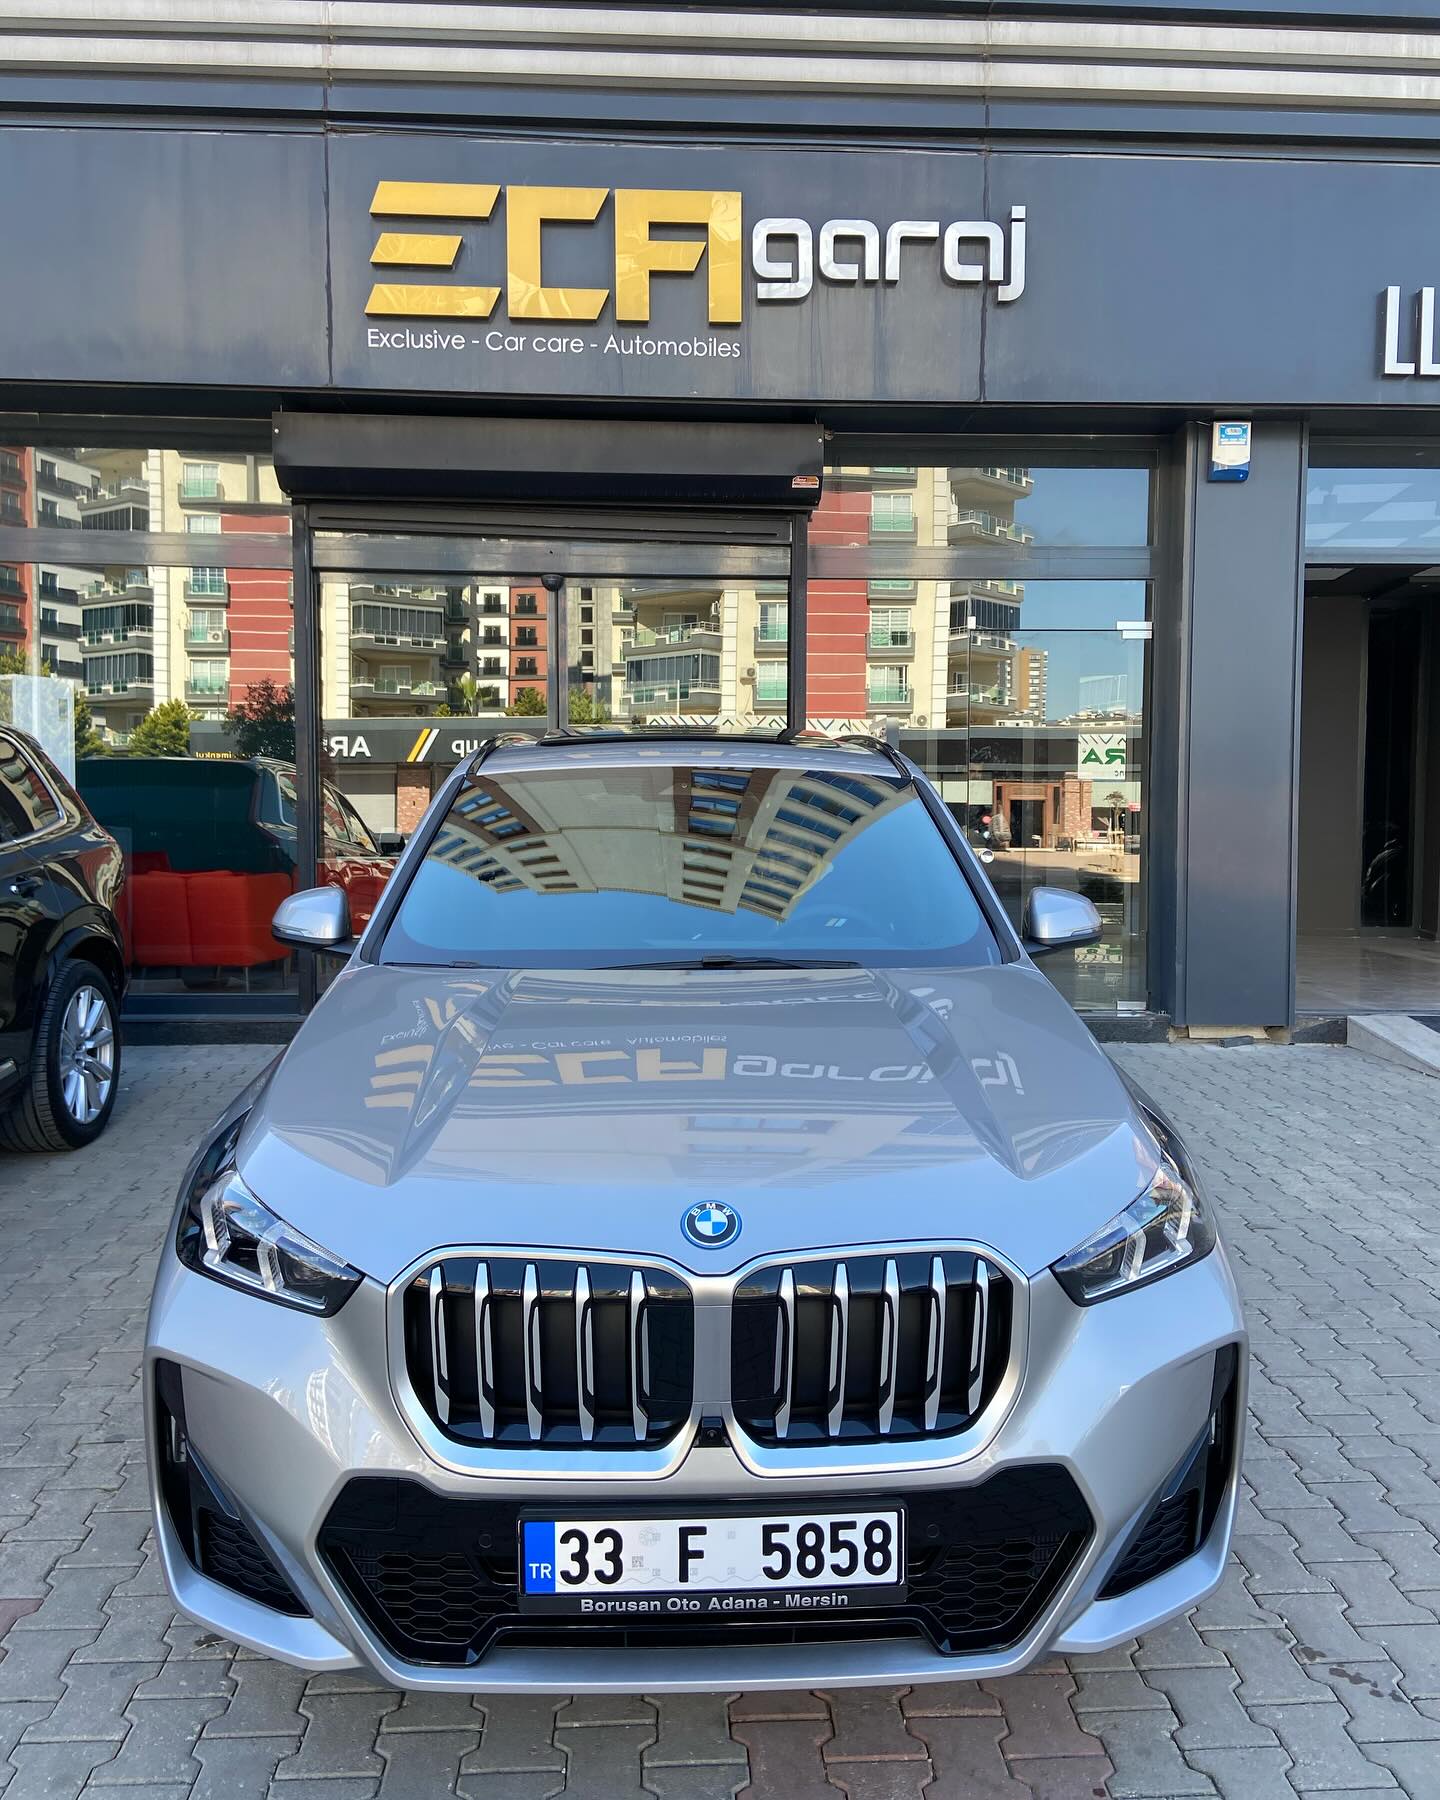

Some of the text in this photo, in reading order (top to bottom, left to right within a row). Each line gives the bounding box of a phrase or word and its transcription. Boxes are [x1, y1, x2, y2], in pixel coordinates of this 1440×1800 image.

[751, 205, 1027, 303] garaj
[366, 328, 466, 350] Exclusive
[485, 331, 527, 352] Car
[532, 336, 584, 352] care
[603, 333, 741, 358] Automobiles
[691, 1202, 733, 1216] BMW
[558, 1518, 893, 1585] 33 F 5858
[529, 1562, 552, 1580] TR
[580, 1597, 661, 1613] Borusan
[666, 1597, 701, 1612] Oto
[707, 1595, 769, 1611] Adana
[784, 1592, 848, 1608] Mersin
